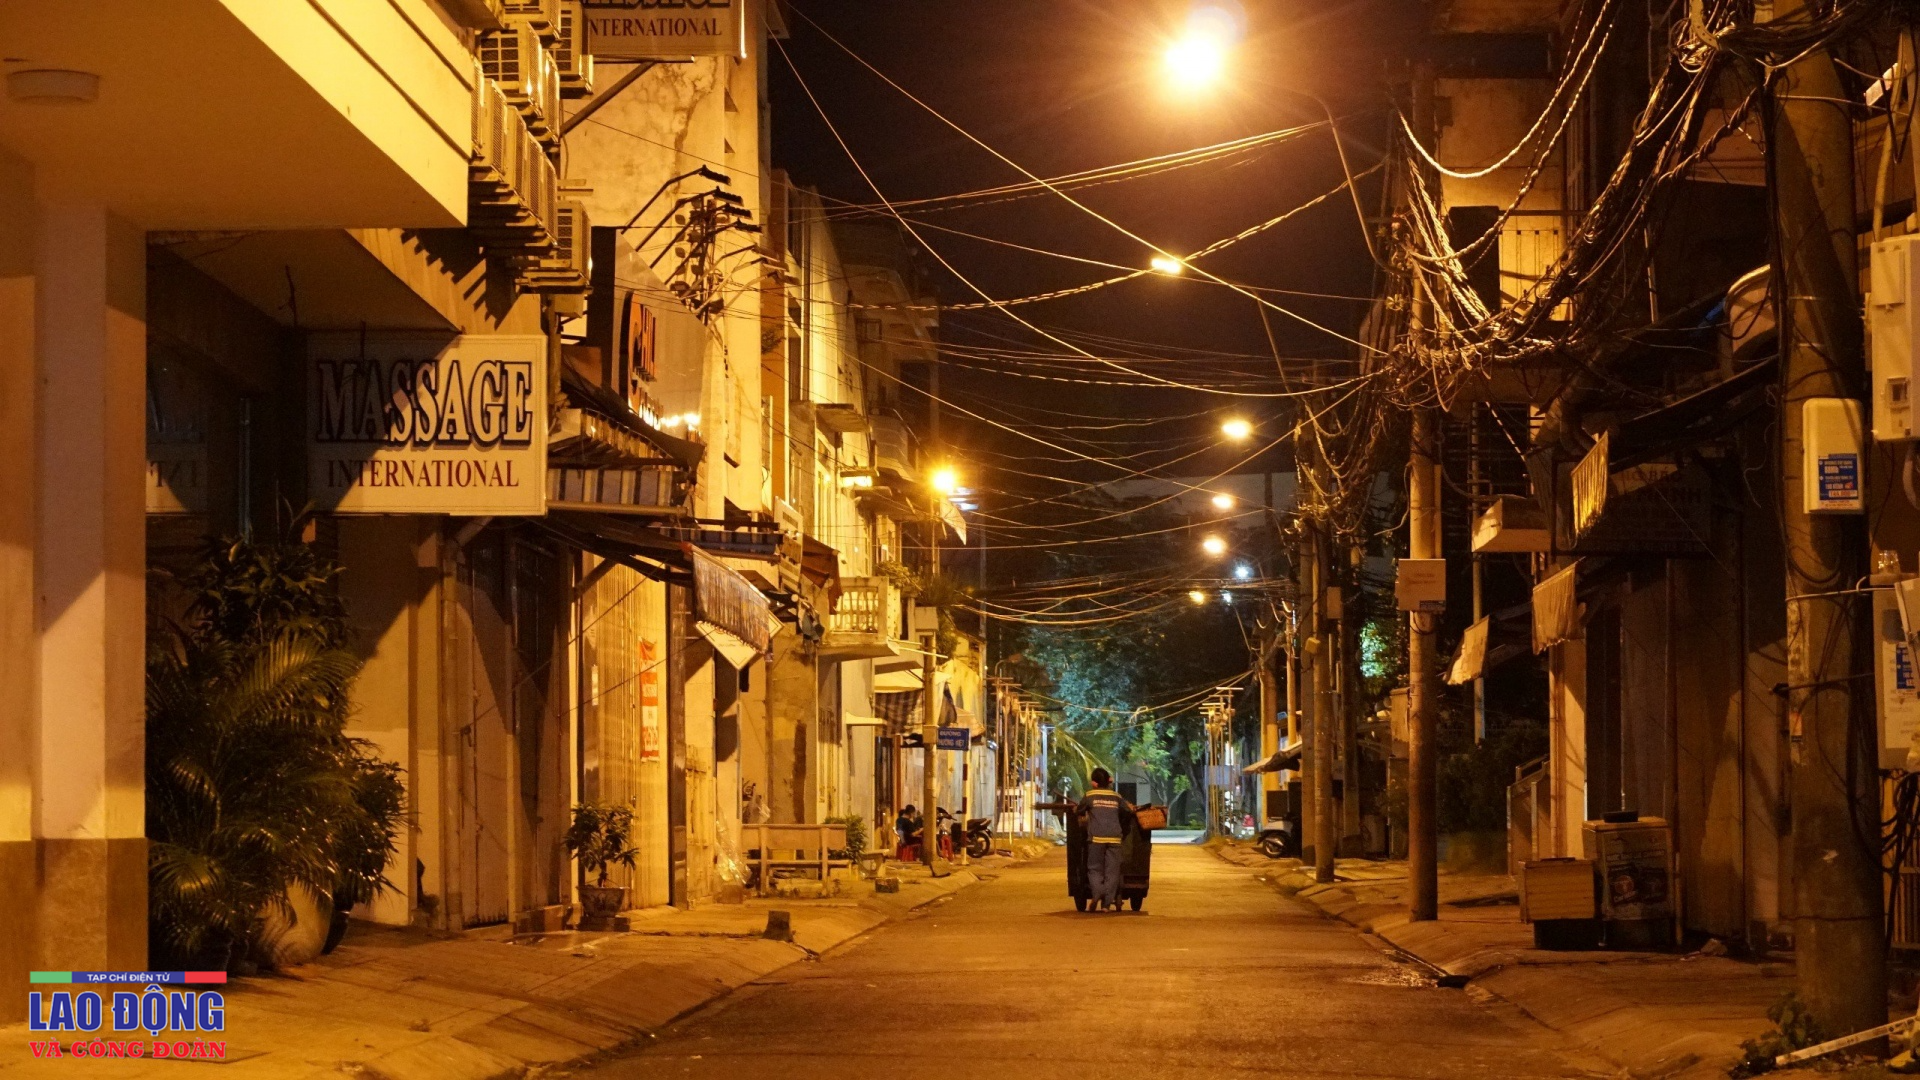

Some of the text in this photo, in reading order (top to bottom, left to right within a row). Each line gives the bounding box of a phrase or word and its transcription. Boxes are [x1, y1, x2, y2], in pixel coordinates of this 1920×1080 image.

[588, 18, 722, 36] NTERNATIONAL
[317, 360, 533, 447] MASSAGE
[328, 459, 519, 488] INTERNATIONAL
